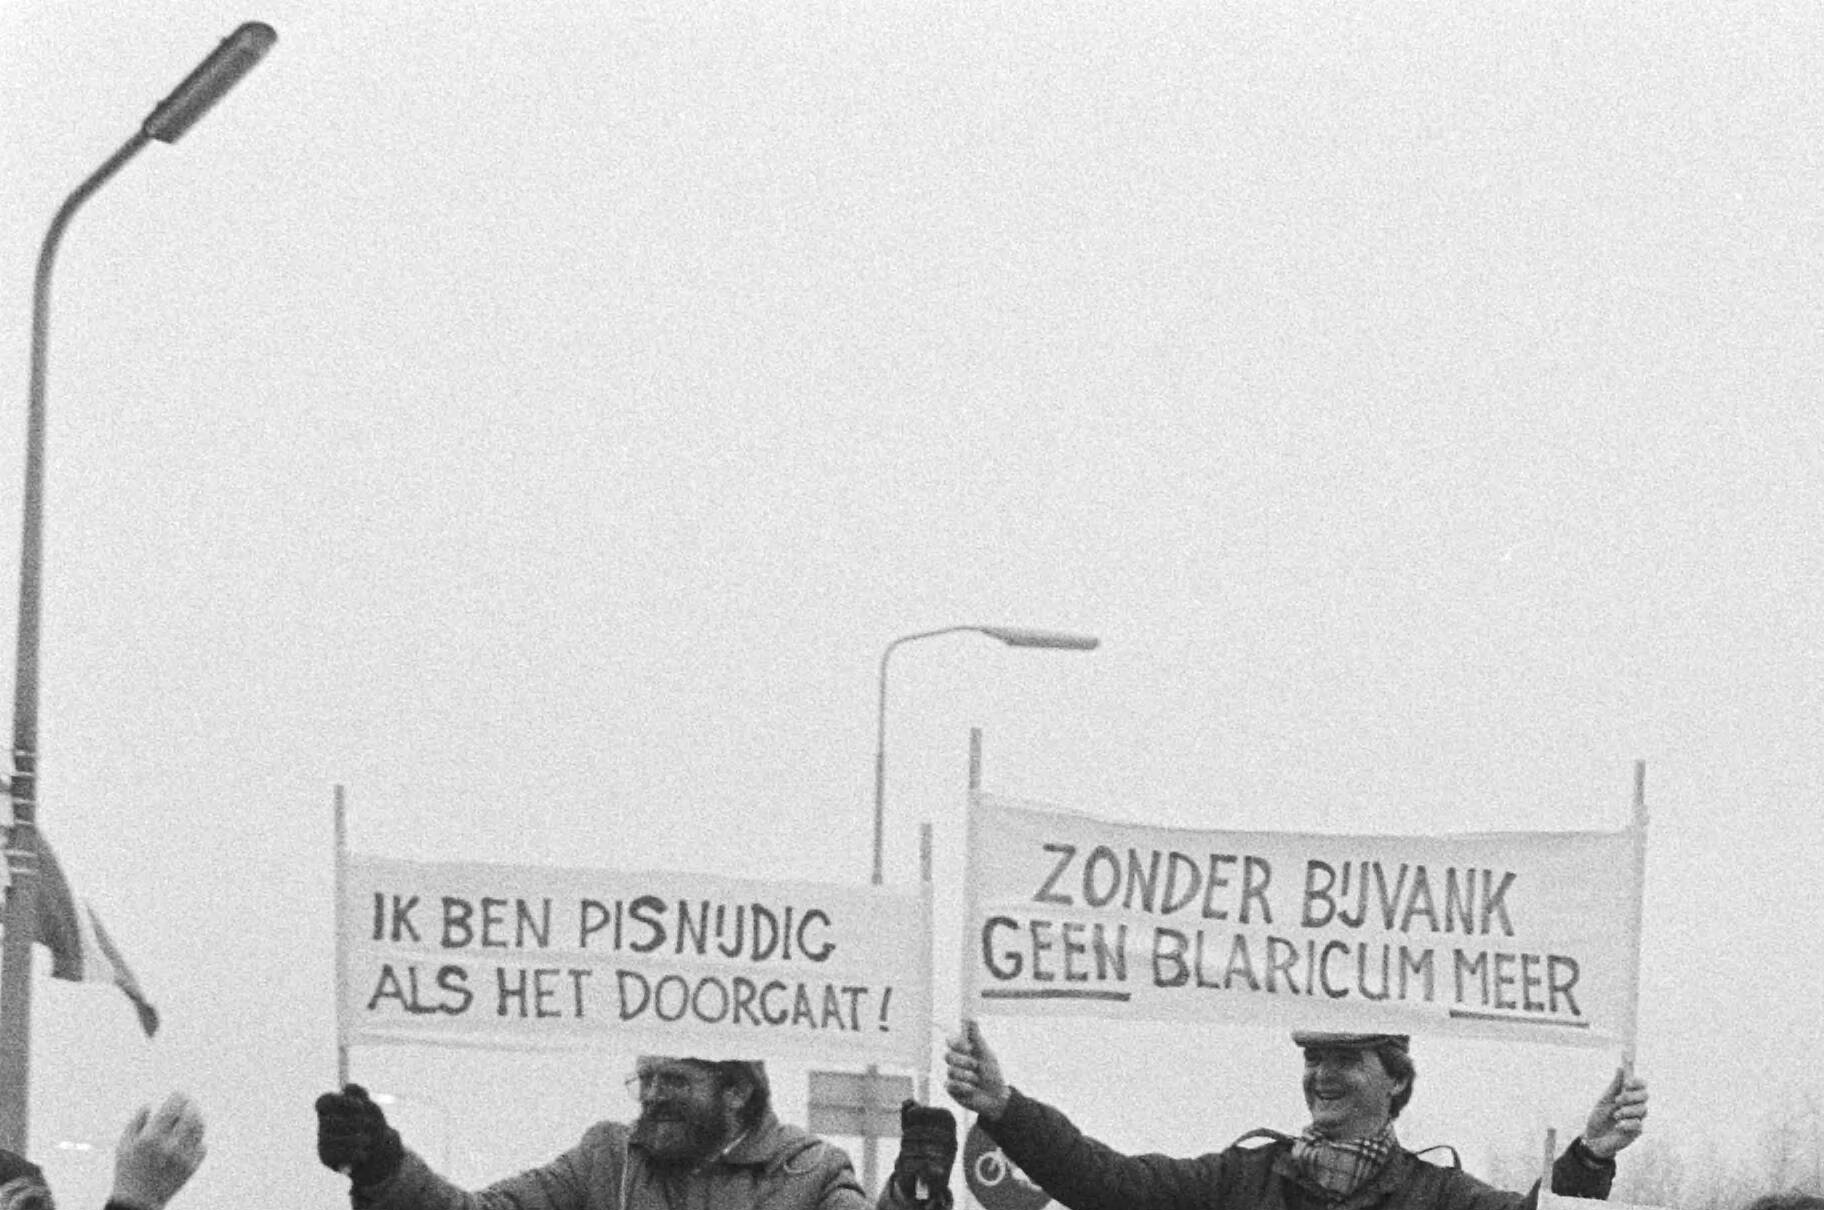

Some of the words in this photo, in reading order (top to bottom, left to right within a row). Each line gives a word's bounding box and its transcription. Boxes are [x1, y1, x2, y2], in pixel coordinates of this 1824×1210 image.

[371, 892, 421, 943] IK
[440, 895, 552, 950] BEN
[1032, 842, 1274, 924] ZONDER
[1301, 858, 1517, 938] BIJVANK
[366, 963, 474, 1016] ALS
[495, 967, 592, 1020] HET
[980, 915, 1128, 985] GEEN
[1152, 926, 1436, 1001] BLARICUM
[1452, 948, 1584, 1018] MEER
